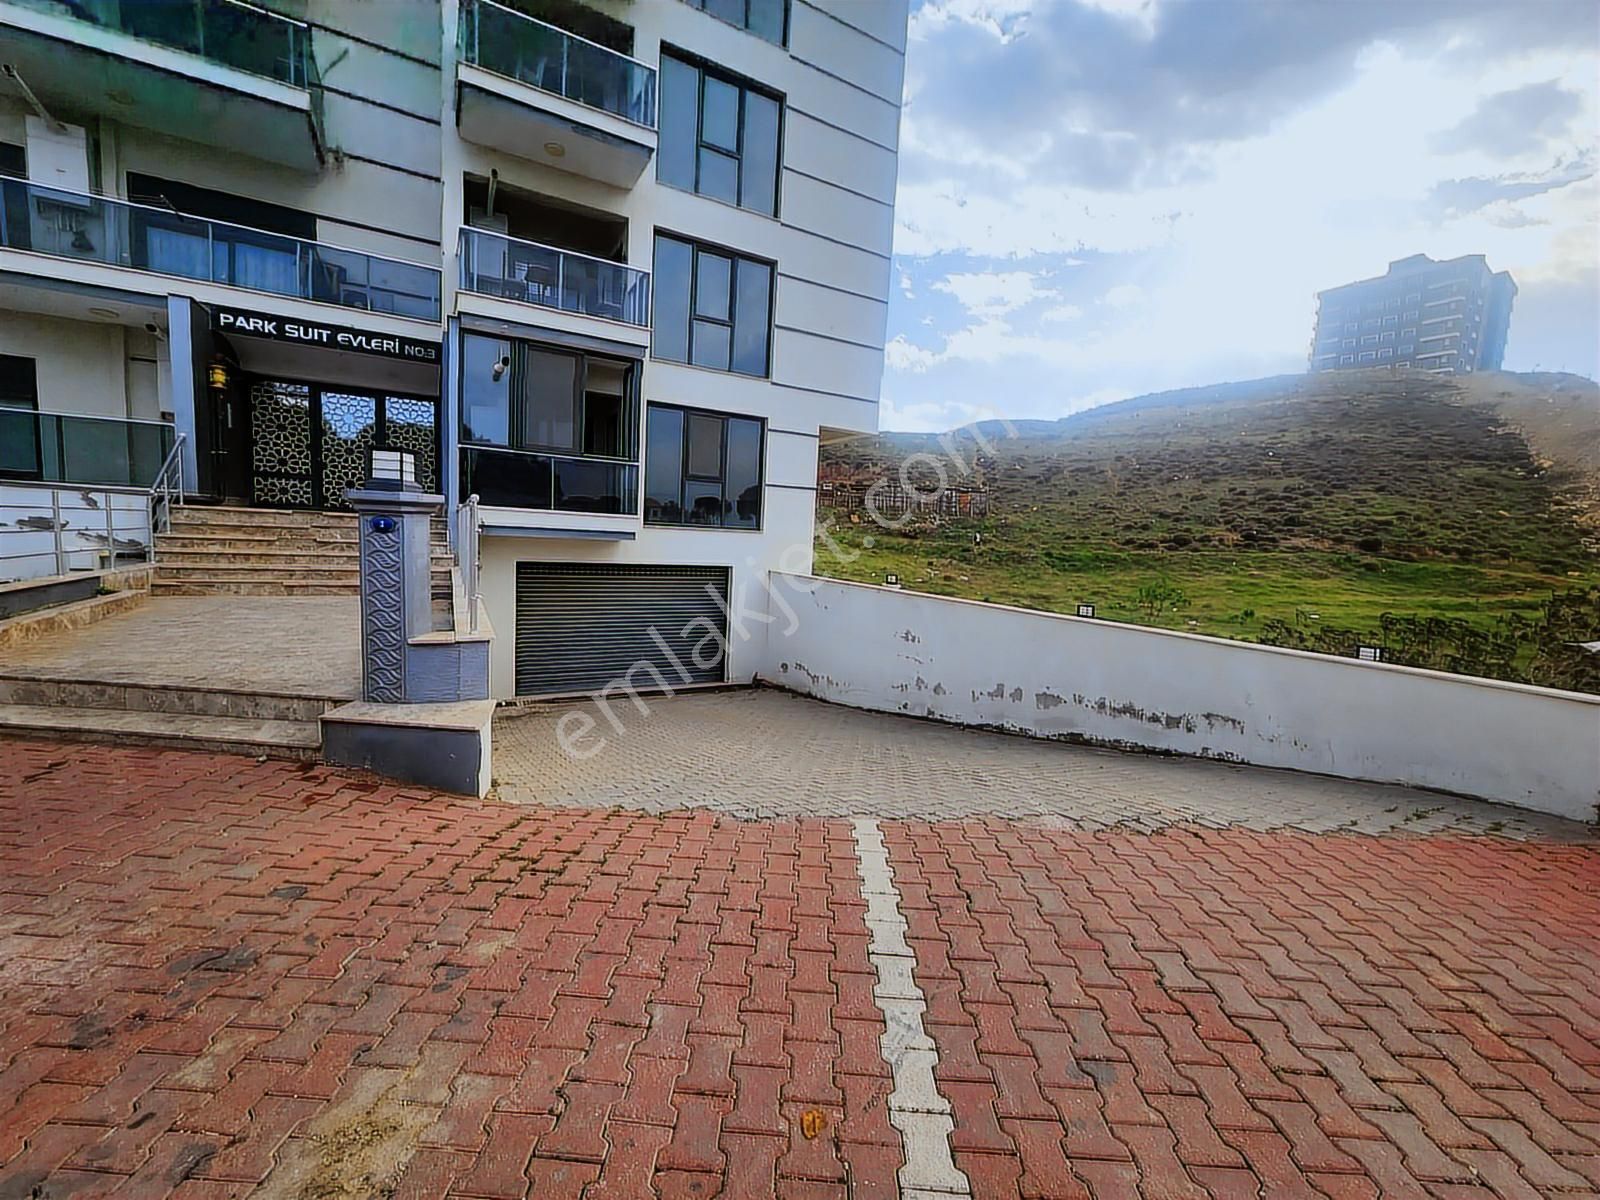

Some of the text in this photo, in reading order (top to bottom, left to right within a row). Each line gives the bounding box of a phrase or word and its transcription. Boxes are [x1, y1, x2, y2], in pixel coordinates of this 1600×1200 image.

[220, 313, 276, 335] PARK
[285, 325, 331, 343] SUIT
[337, 333, 399, 355] EVLERİ
